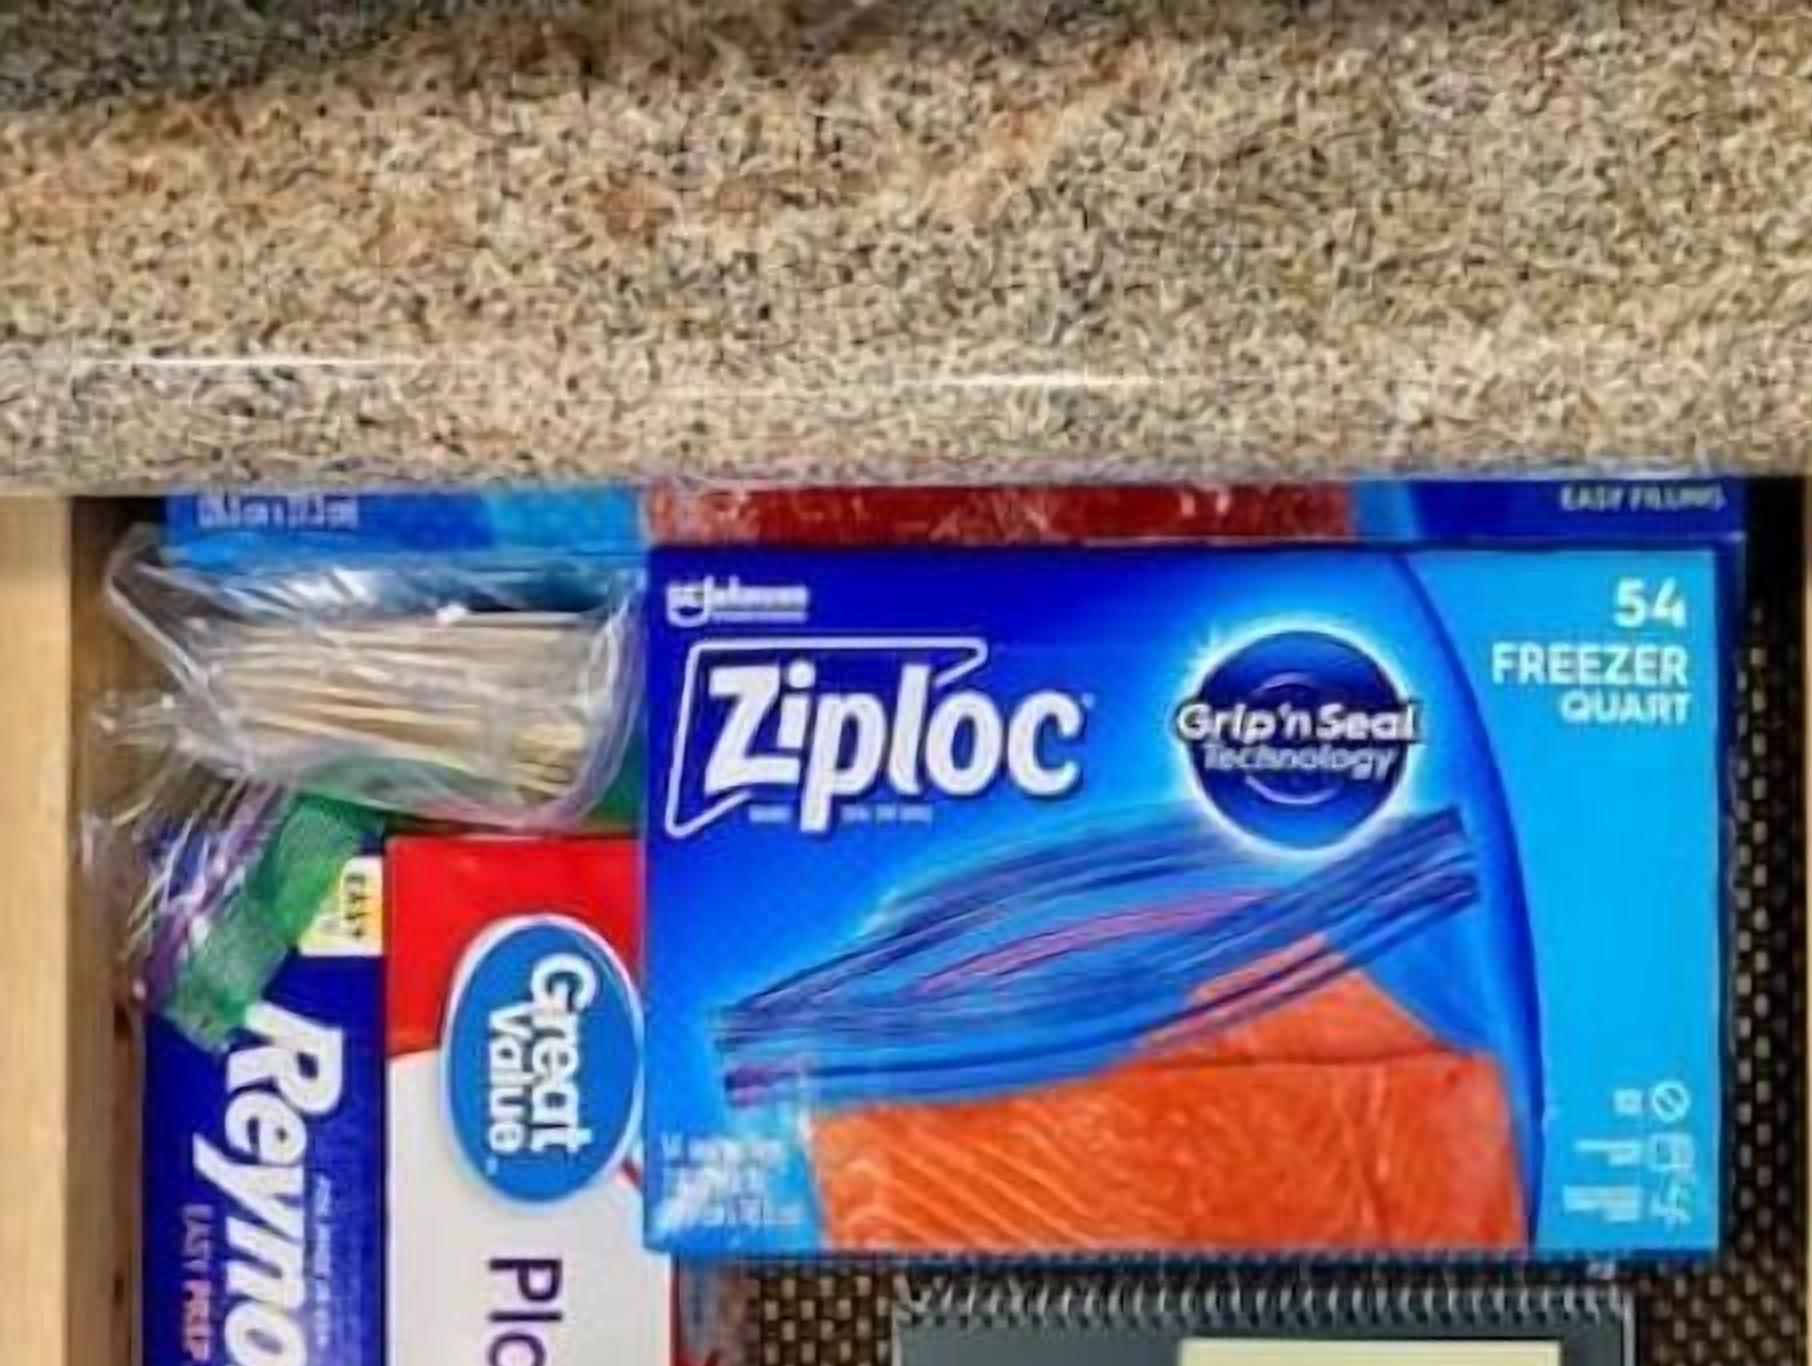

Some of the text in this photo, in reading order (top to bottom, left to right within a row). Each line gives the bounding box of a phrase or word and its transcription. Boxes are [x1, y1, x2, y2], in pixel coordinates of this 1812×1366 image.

[1613, 577, 1687, 628] 54
[1491, 641, 1689, 687] FREEZER
[1559, 690, 1691, 725] QUART
[704, 662, 1084, 832] Ziploc
[489, 1001, 536, 1154] Value
[530, 953, 596, 1154] Great
